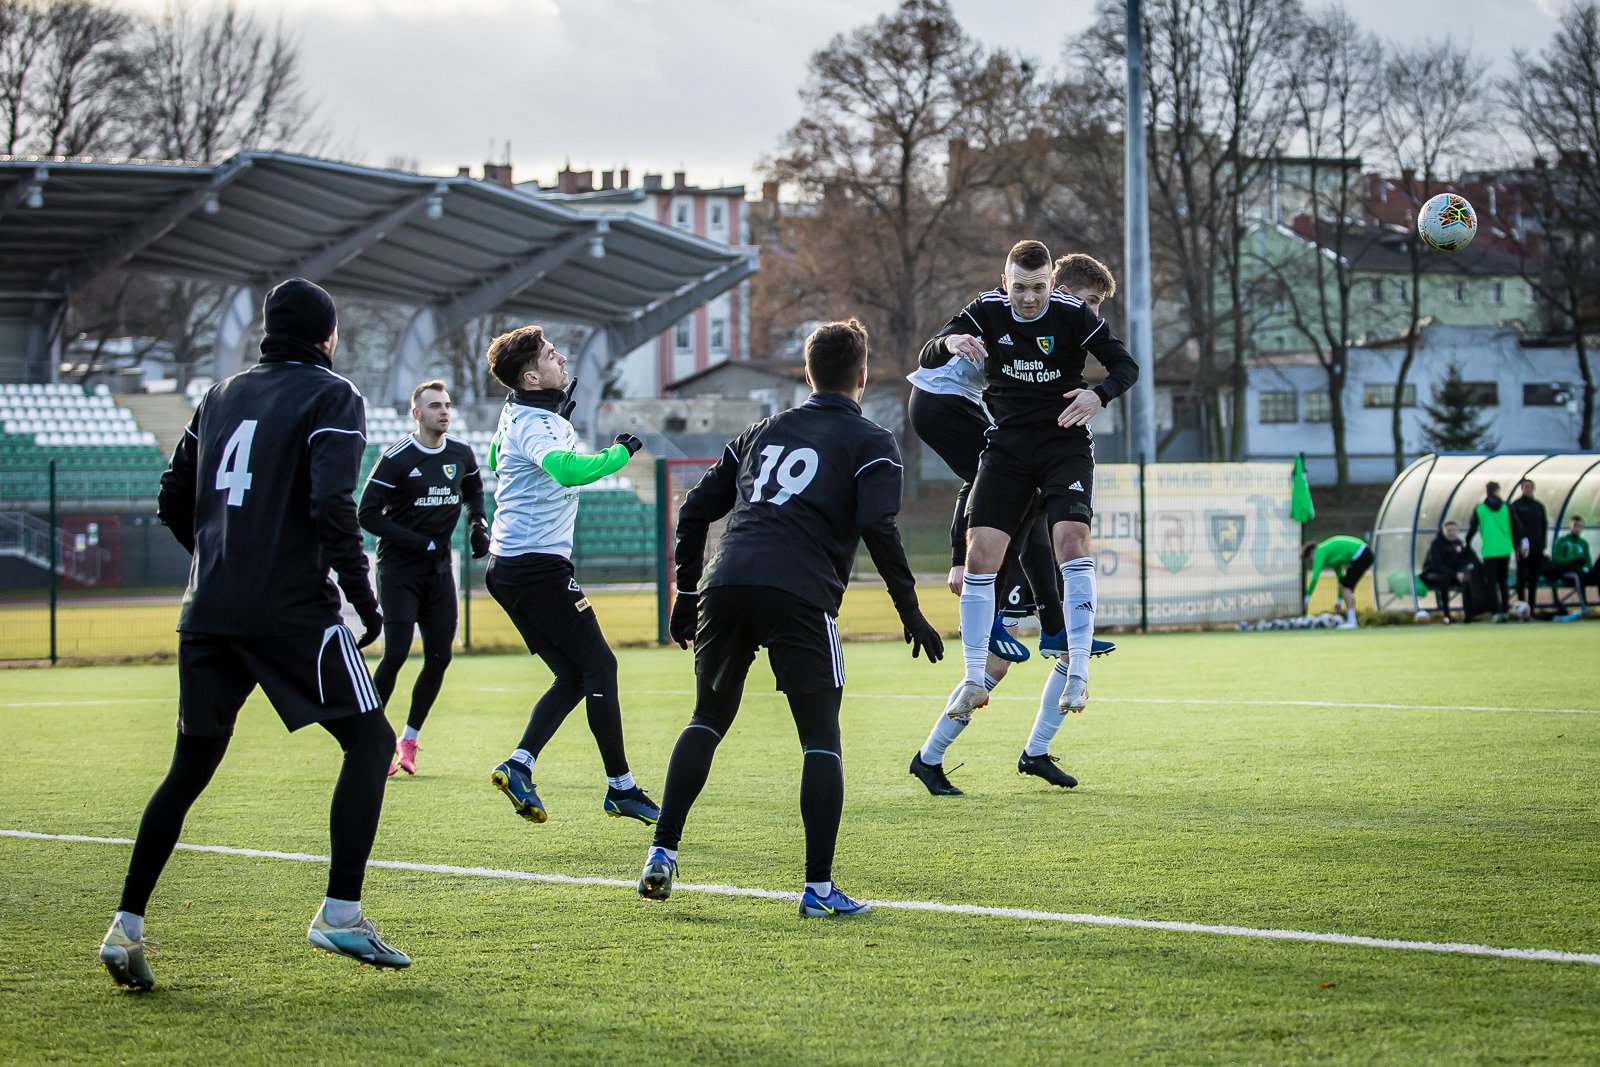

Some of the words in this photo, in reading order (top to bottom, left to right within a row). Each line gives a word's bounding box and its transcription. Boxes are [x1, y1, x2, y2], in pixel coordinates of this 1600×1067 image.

[1002, 364, 1035, 383] JELENIA
[1036, 368, 1061, 383] GÓRA
[1013, 359, 1044, 371] Miasto
[215, 419, 258, 507] 4
[749, 444, 819, 506] 19
[428, 486, 451, 495] Miasto
[414, 496, 442, 506] JELENIA
[1008, 585, 1021, 605] 6
